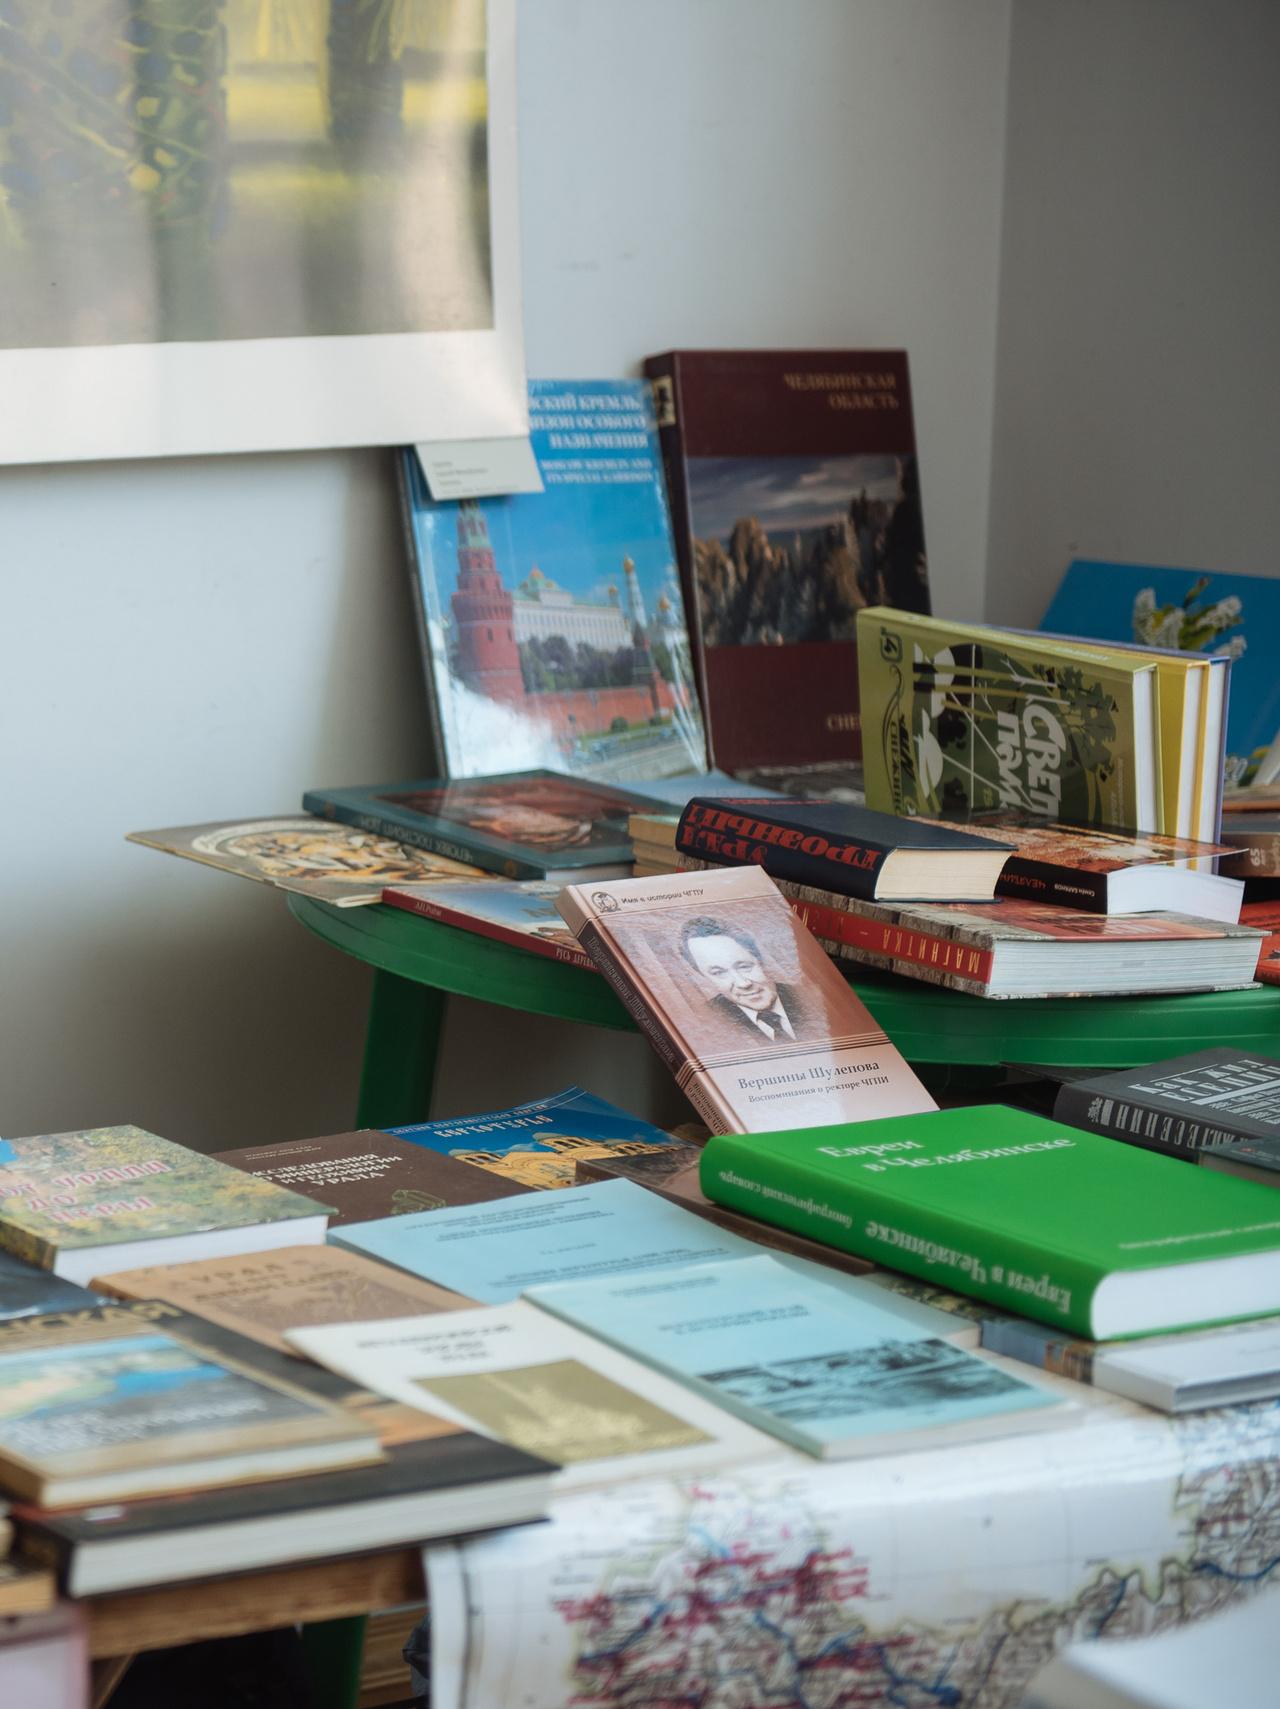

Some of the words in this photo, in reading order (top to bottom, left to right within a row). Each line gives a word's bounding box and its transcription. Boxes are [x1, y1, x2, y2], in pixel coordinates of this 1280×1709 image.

[783, 372, 898, 391] ЧЕЛЯБИНСКАЯ
[828, 392, 900, 411] ОБЛАСТЬ
[436, 838, 474, 863] ЧЕЛОВЕК
[680, 825, 769, 867] УРАЛ
[685, 804, 883, 871] ГРОЗНЫЙ
[1249, 848, 1261, 867] 65
[647, 891, 682, 903] истории
[682, 888, 704, 897] ЧГПУ
[555, 947, 572, 965] РУСЬ
[882, 928, 981, 974] МАГНИТКА
[587, 936, 633, 1000] Вершины
[629, 996, 676, 1063] Шулепова
[738, 1071, 807, 1091] Вершины
[808, 1062, 880, 1080] Шулепова
[748, 1087, 817, 1103] Воспоминания
[825, 1081, 861, 1094] ректоре
[861, 1075, 890, 1087] ЧГПИ
[1115, 1103, 1201, 1149] ЕСЕНИН
[818, 1140, 925, 1158] Евреи
[863, 1162, 887, 1172] в
[881, 1138, 1077, 1168] Челябинске
[51, 1159, 172, 1189] УРАЛА
[274, 1155, 403, 1180] МИНЕРАЛОГИИ
[296, 1163, 392, 1183] ГЕОХИМИИ
[310, 1171, 386, 1187] УРАЛА
[718, 1170, 761, 1193] словарь
[27, 1193, 78, 1213] ДО
[46, 1195, 157, 1224] НЕВЫ
[762, 1185, 853, 1229] биографический
[865, 1220, 987, 1284] Челябинске
[990, 1264, 1004, 1283] в
[1007, 1270, 1072, 1315] Евреи
